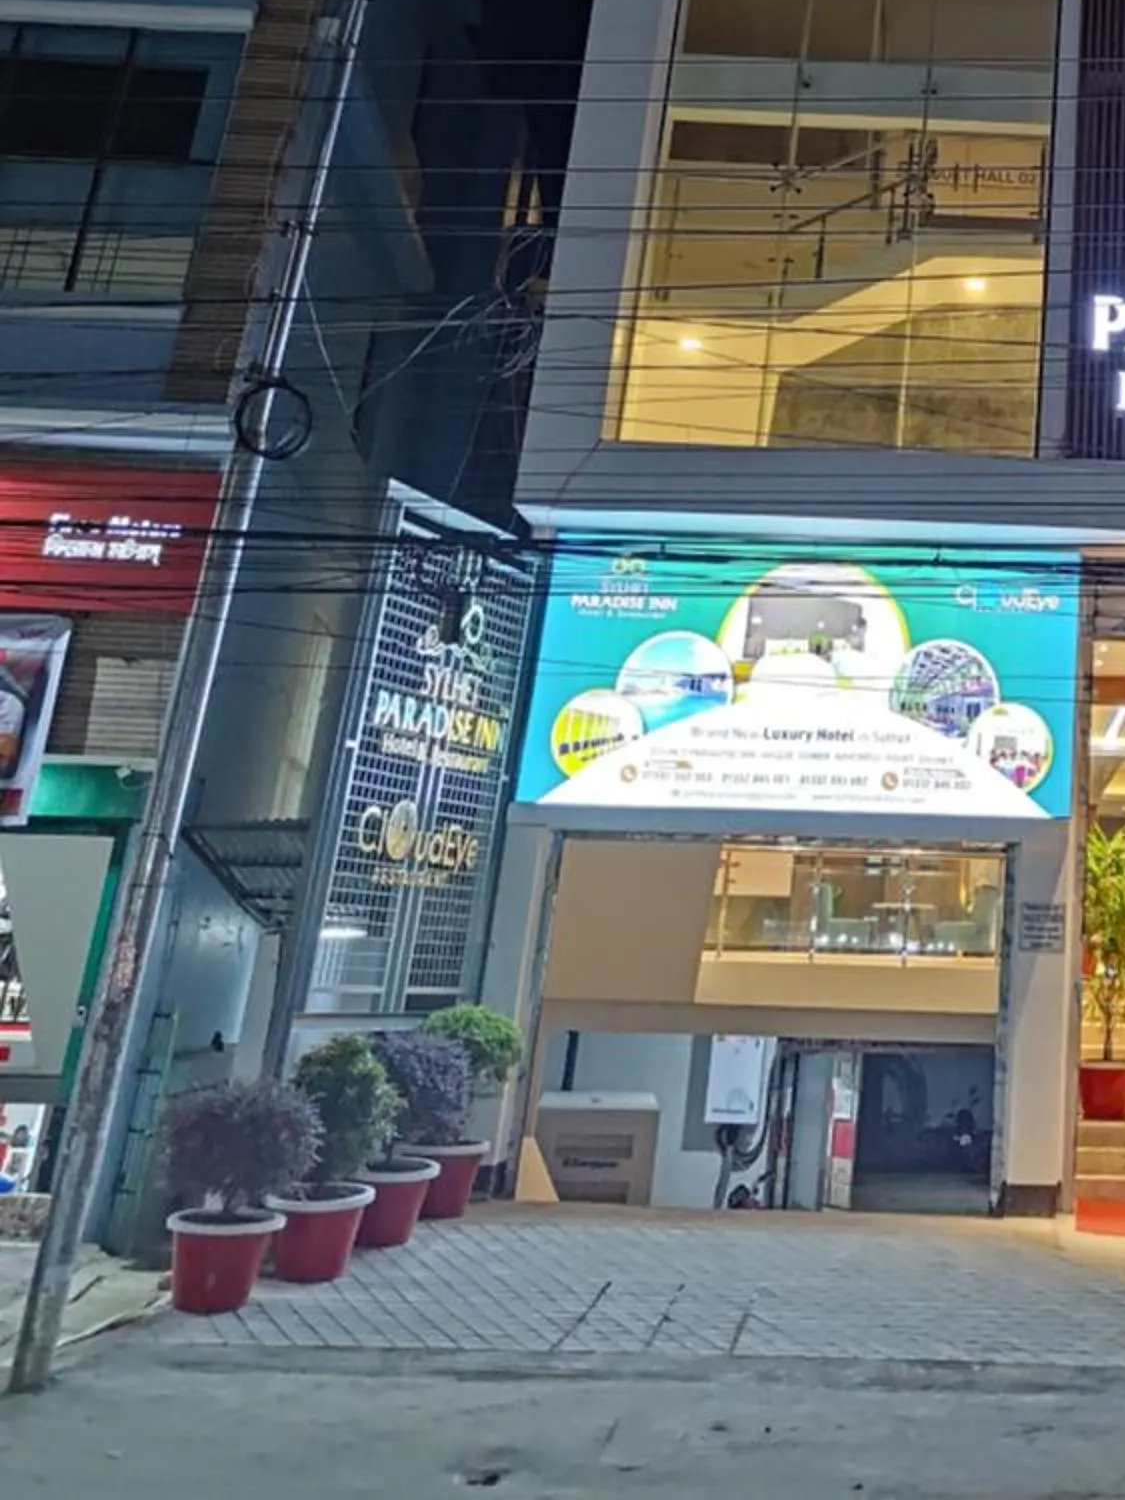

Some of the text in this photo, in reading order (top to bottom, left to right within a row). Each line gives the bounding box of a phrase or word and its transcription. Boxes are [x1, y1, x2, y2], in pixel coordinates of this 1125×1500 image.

[570, 594, 679, 612] PARADISE INN
[421, 663, 483, 706] SYLHET
[374, 690, 474, 743] PARADISE
[763, 727, 813, 743] Luxury
[816, 729, 855, 742] Hotel
